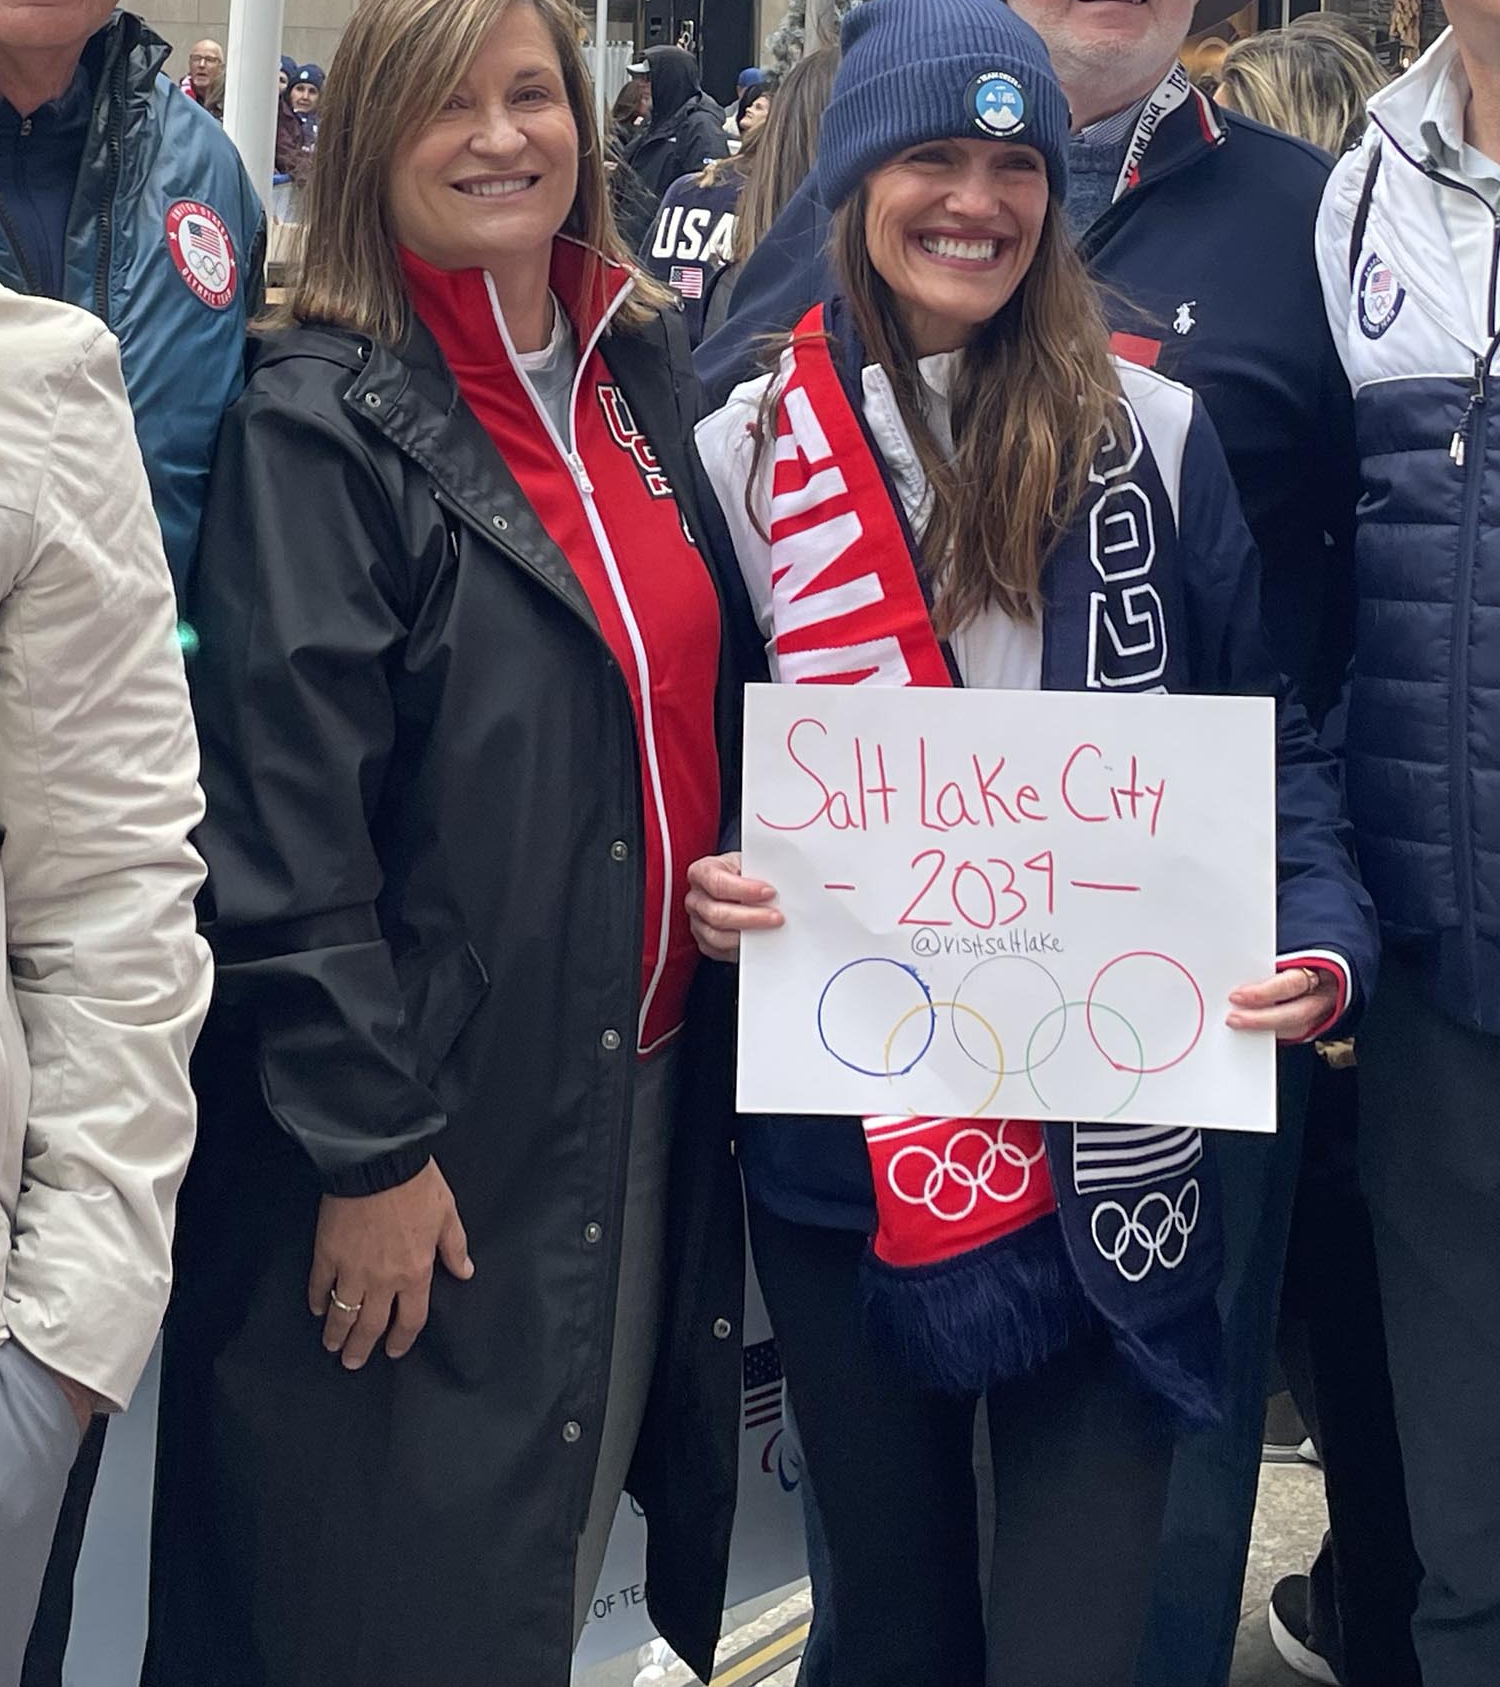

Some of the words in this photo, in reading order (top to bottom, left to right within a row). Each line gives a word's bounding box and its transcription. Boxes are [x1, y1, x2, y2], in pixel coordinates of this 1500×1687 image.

[1139, 102, 1167, 136] USA
[651, 205, 736, 265] USA
[755, 718, 898, 831] Salt
[1060, 742, 1166, 836] City
[910, 927, 1065, 957] @visitsaltlake
[593, 1594, 616, 1619] OF
